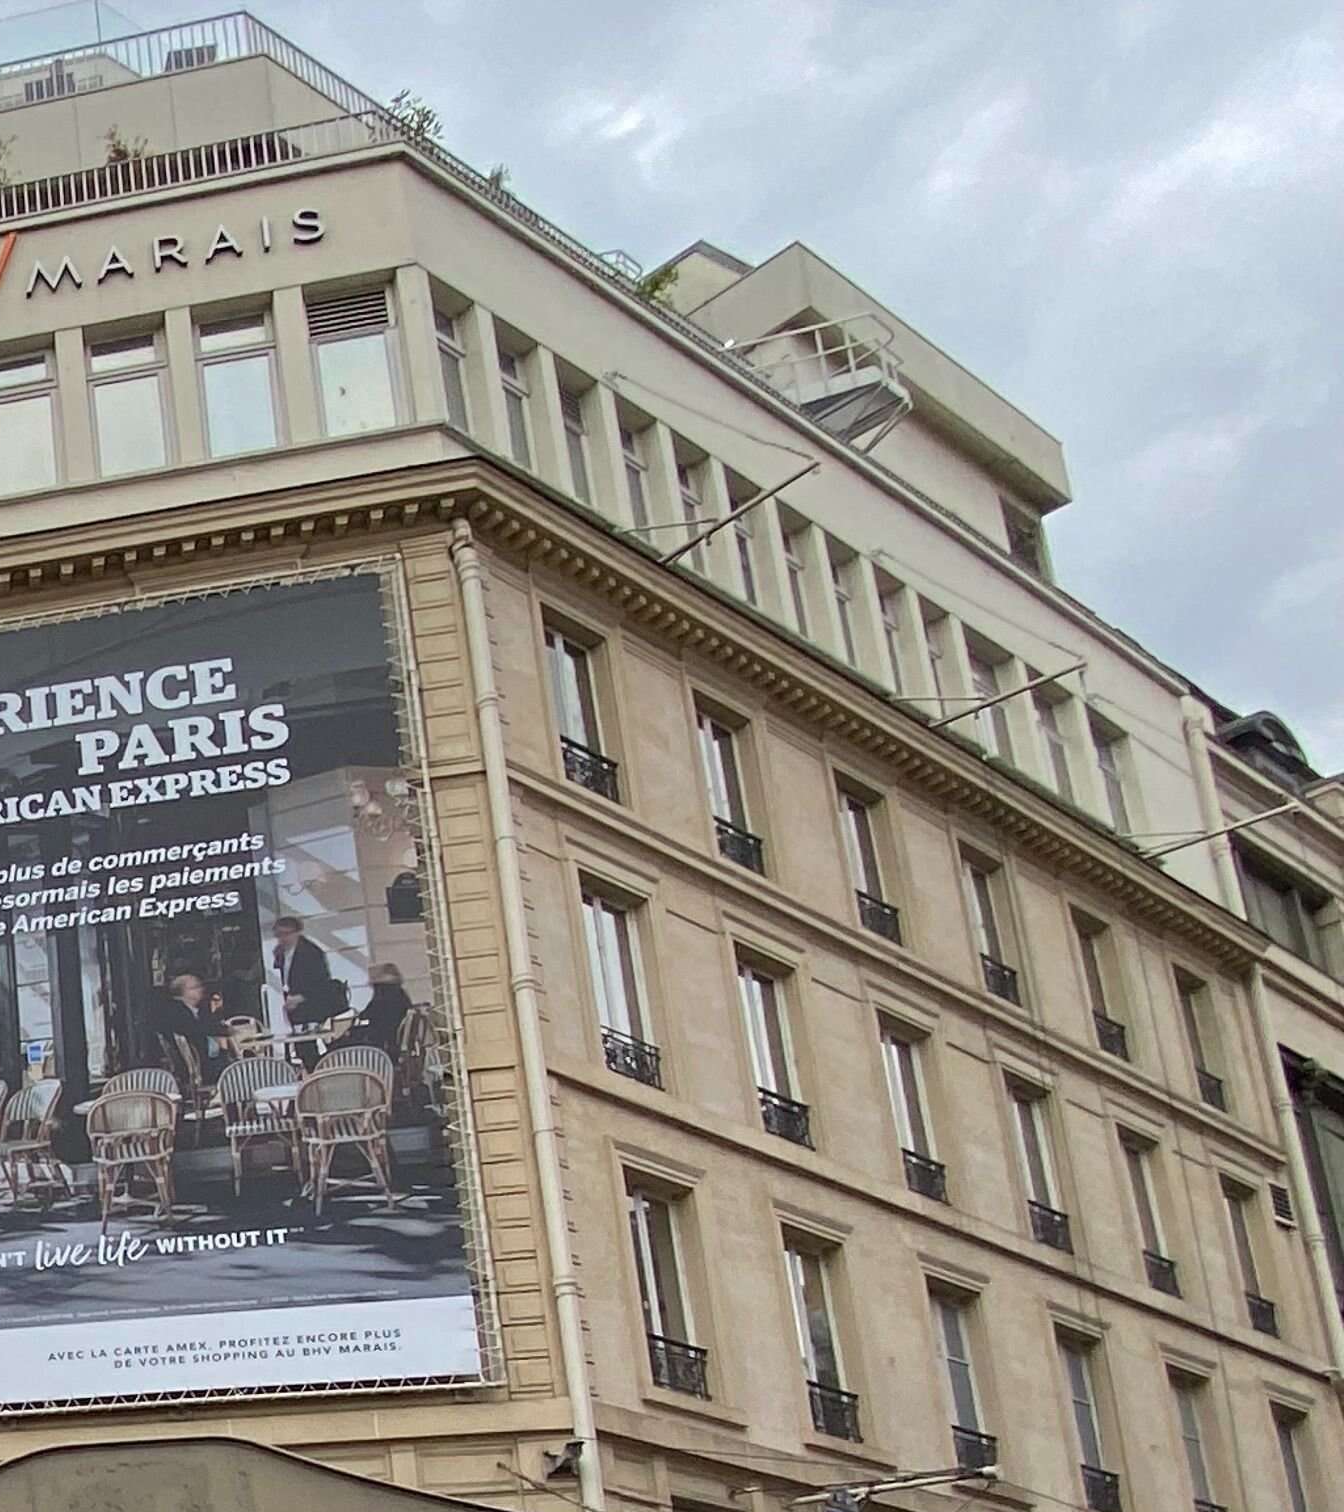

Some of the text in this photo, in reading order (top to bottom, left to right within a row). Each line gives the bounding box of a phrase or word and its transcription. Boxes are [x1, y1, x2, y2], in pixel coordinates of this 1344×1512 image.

[75, 704, 290, 776] PARIS
[109, 758, 291, 809] EXPRESS
[51, 855, 82, 876] de
[88, 832, 266, 873] commerçants
[107, 875, 144, 896] les
[150, 856, 287, 898] paiements
[12, 902, 132, 937] American
[138, 889, 240, 922] Express
[35, 1239, 93, 1271] live
[97, 1230, 152, 1267] life
[155, 1230, 260, 1255] WITHOUT
[48, 1350, 85, 1361] AVEC
[90, 1348, 108, 1359] LA
[113, 1344, 159, 1357] CARTE
[218, 1335, 290, 1349] PROFITEZ
[296, 1331, 357, 1344] ENCORE
[363, 1328, 402, 1340] PLUS
[113, 1359, 133, 1369] DE
[140, 1355, 186, 1367] VOTRE
[192, 1350, 269, 1364] SHOPPING
[274, 1347, 295, 1358] AU
[302, 1344, 333, 1356] BHV
